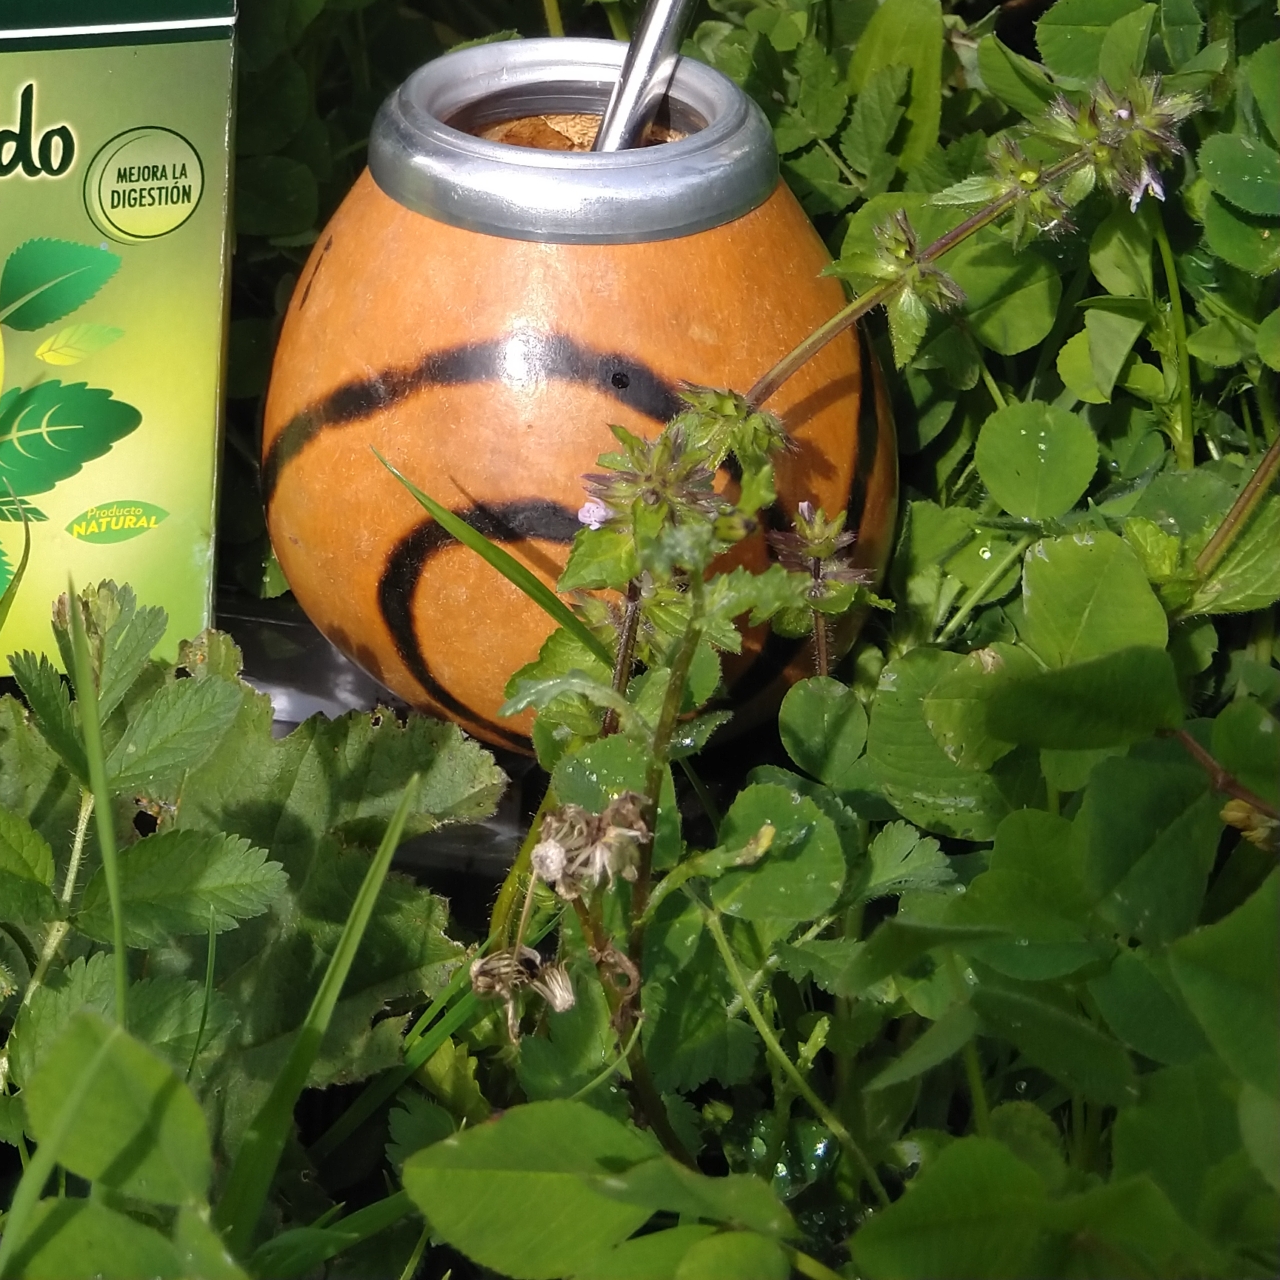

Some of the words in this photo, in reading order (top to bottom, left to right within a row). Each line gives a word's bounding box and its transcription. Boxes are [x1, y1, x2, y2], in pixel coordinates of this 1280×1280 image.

[116, 164, 168, 184] MEJORA
[172, 163, 188, 180] LA
[110, 180, 192, 209] DIGESTIÓN
[87, 504, 143, 519] Producto
[72, 516, 159, 538] NATURAL
